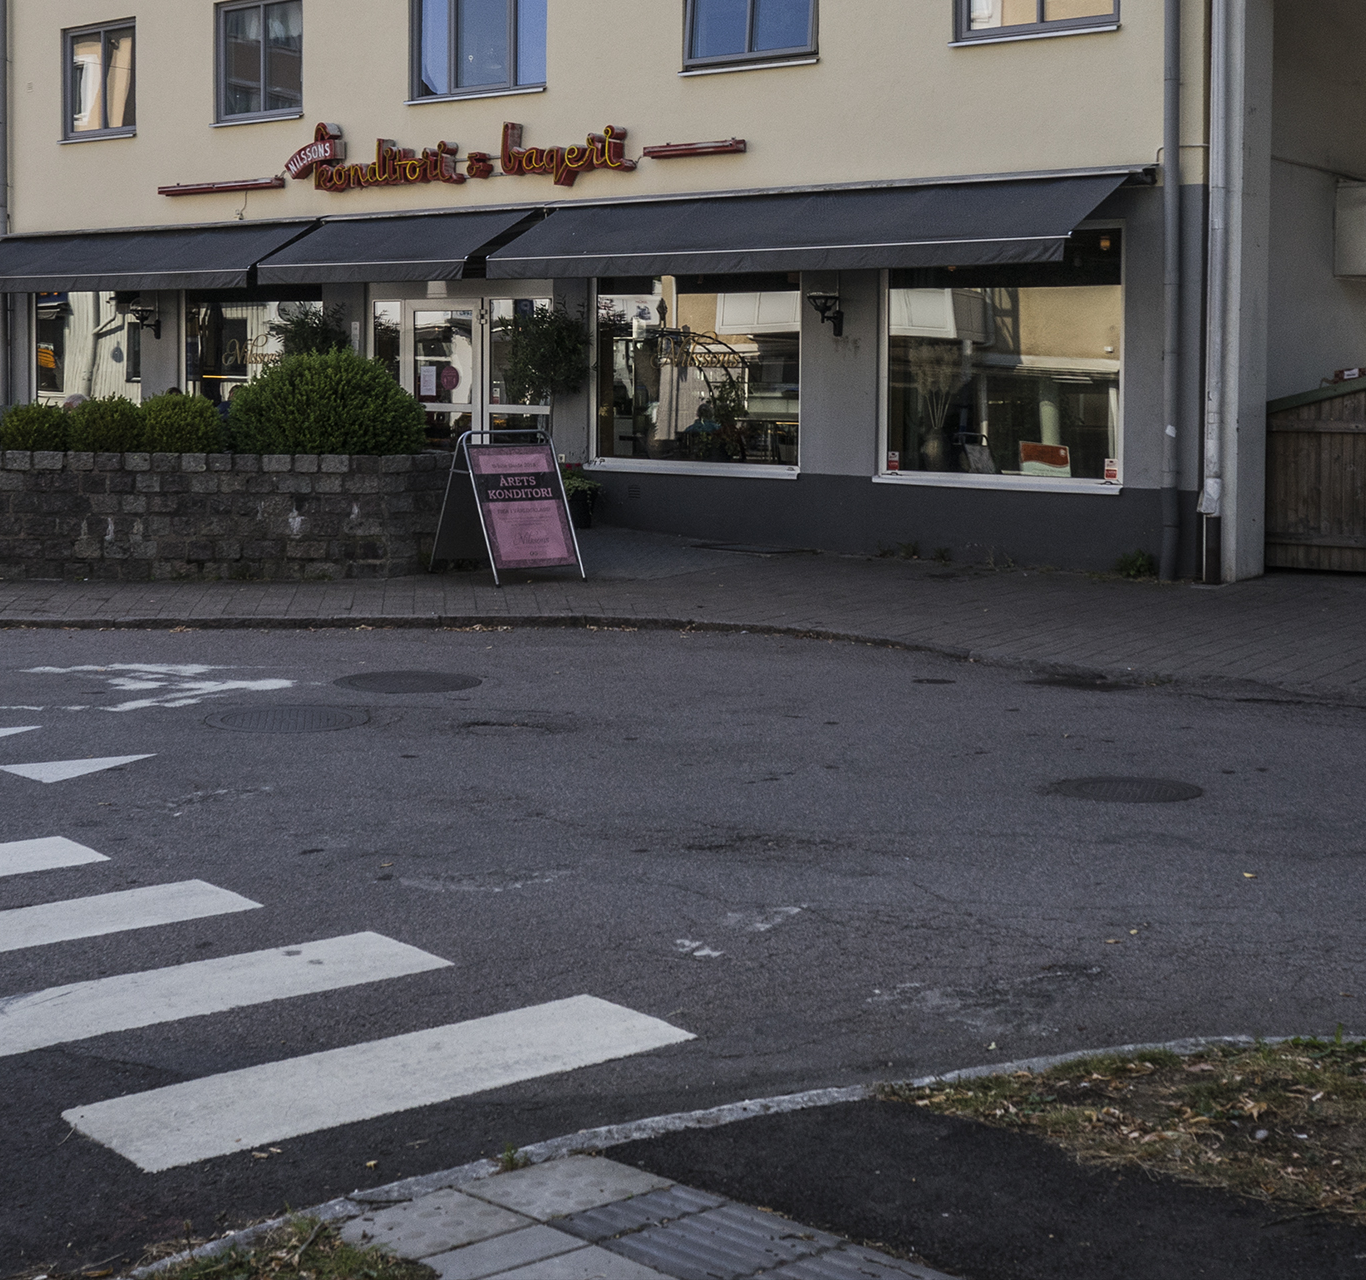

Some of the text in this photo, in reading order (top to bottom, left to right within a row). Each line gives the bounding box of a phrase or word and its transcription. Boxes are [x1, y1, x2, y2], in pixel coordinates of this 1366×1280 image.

[288, 143, 331, 174] NILSSONS
[500, 121, 637, 187] bageri
[650, 331, 739, 369] Nilssons
[487, 488, 553, 500] KONDITORI
[499, 475, 537, 487] ÅRETS
